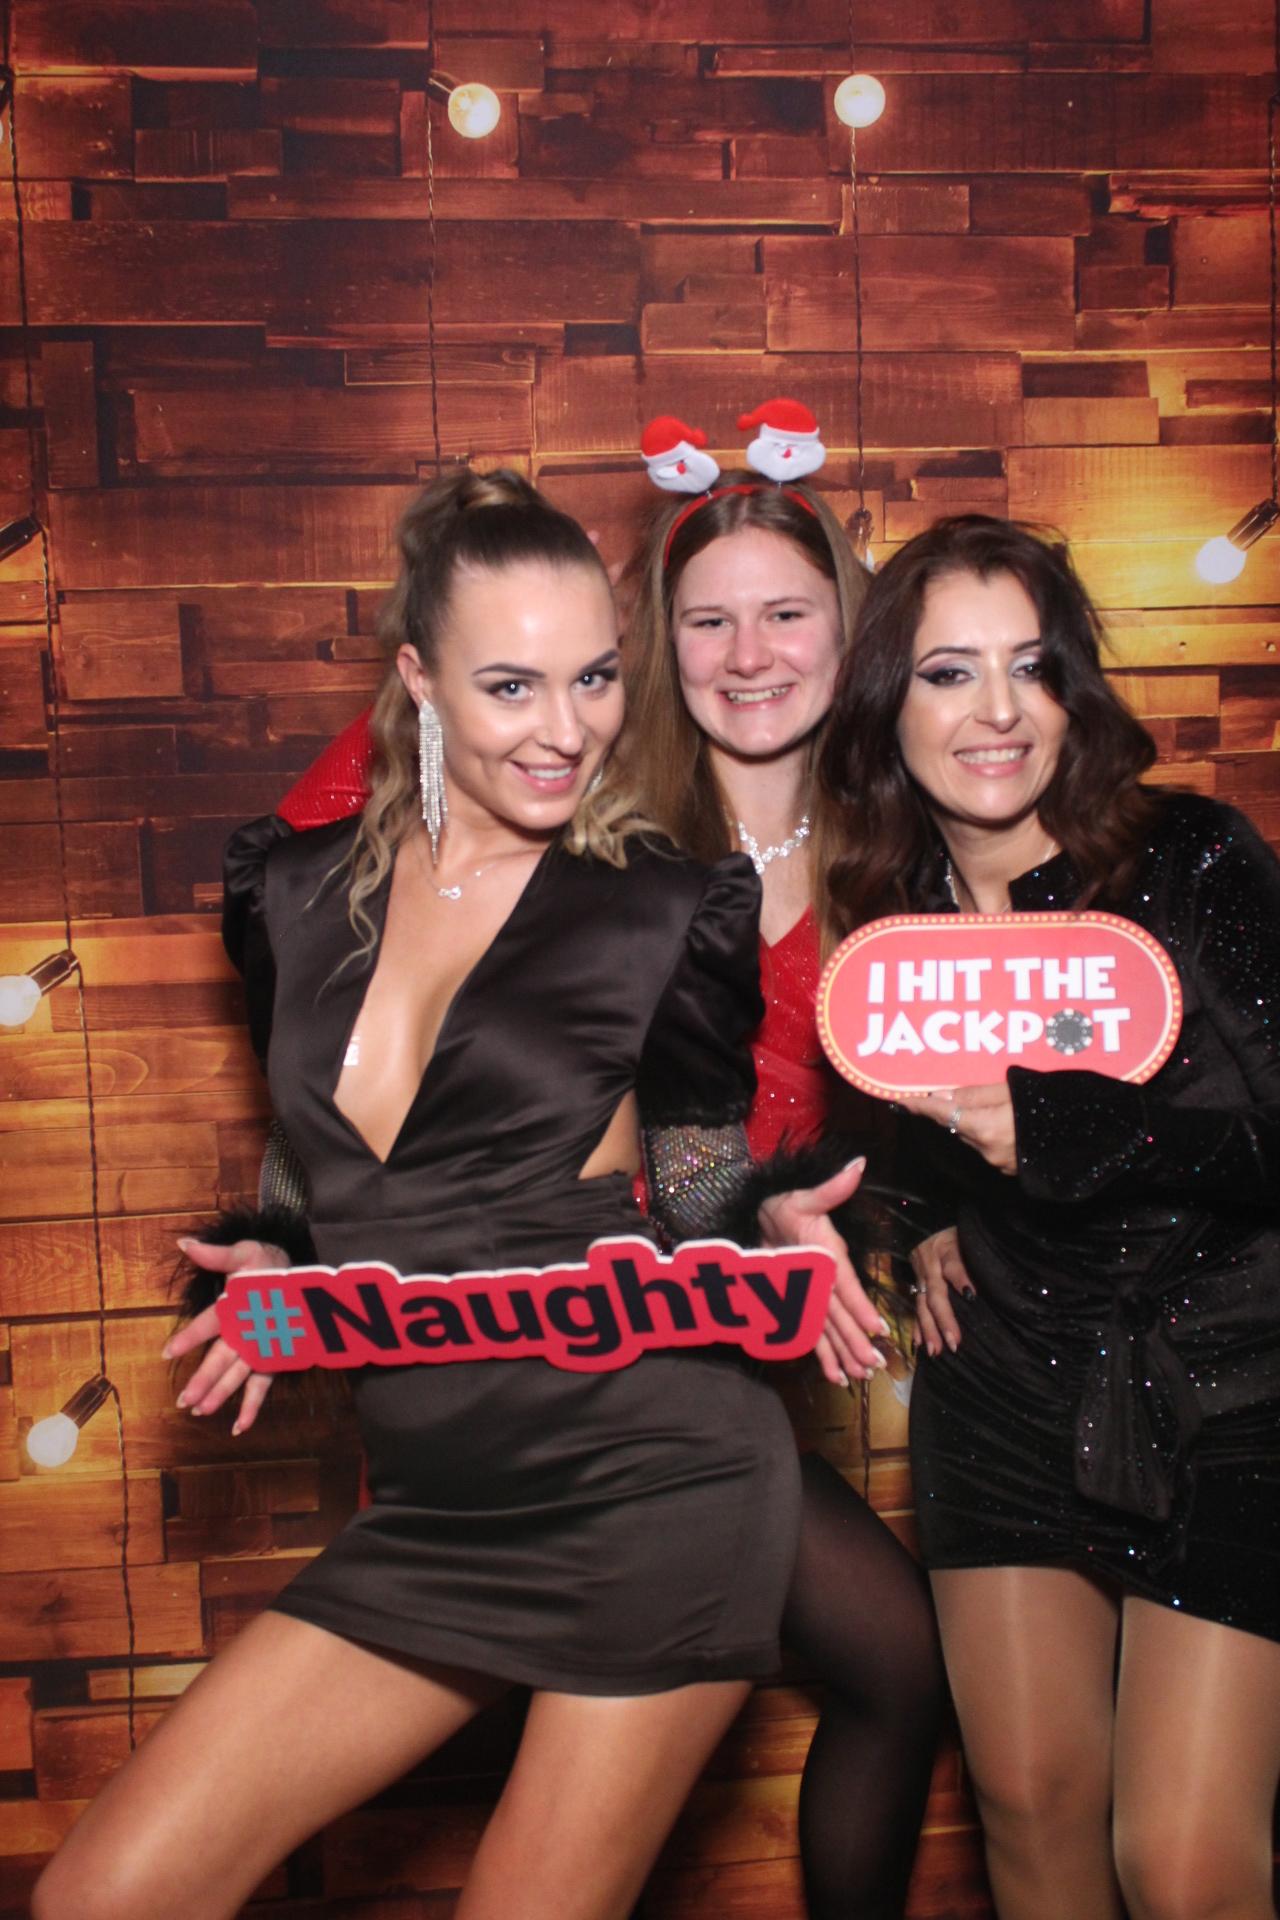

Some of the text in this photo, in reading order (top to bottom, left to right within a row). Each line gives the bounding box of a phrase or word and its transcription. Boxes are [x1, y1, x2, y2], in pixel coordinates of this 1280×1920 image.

[868, 956, 1116, 1003] I HIT THE
[857, 1007, 1130, 1057] JACKPOT
[236, 1258, 814, 1358] #Naughty
